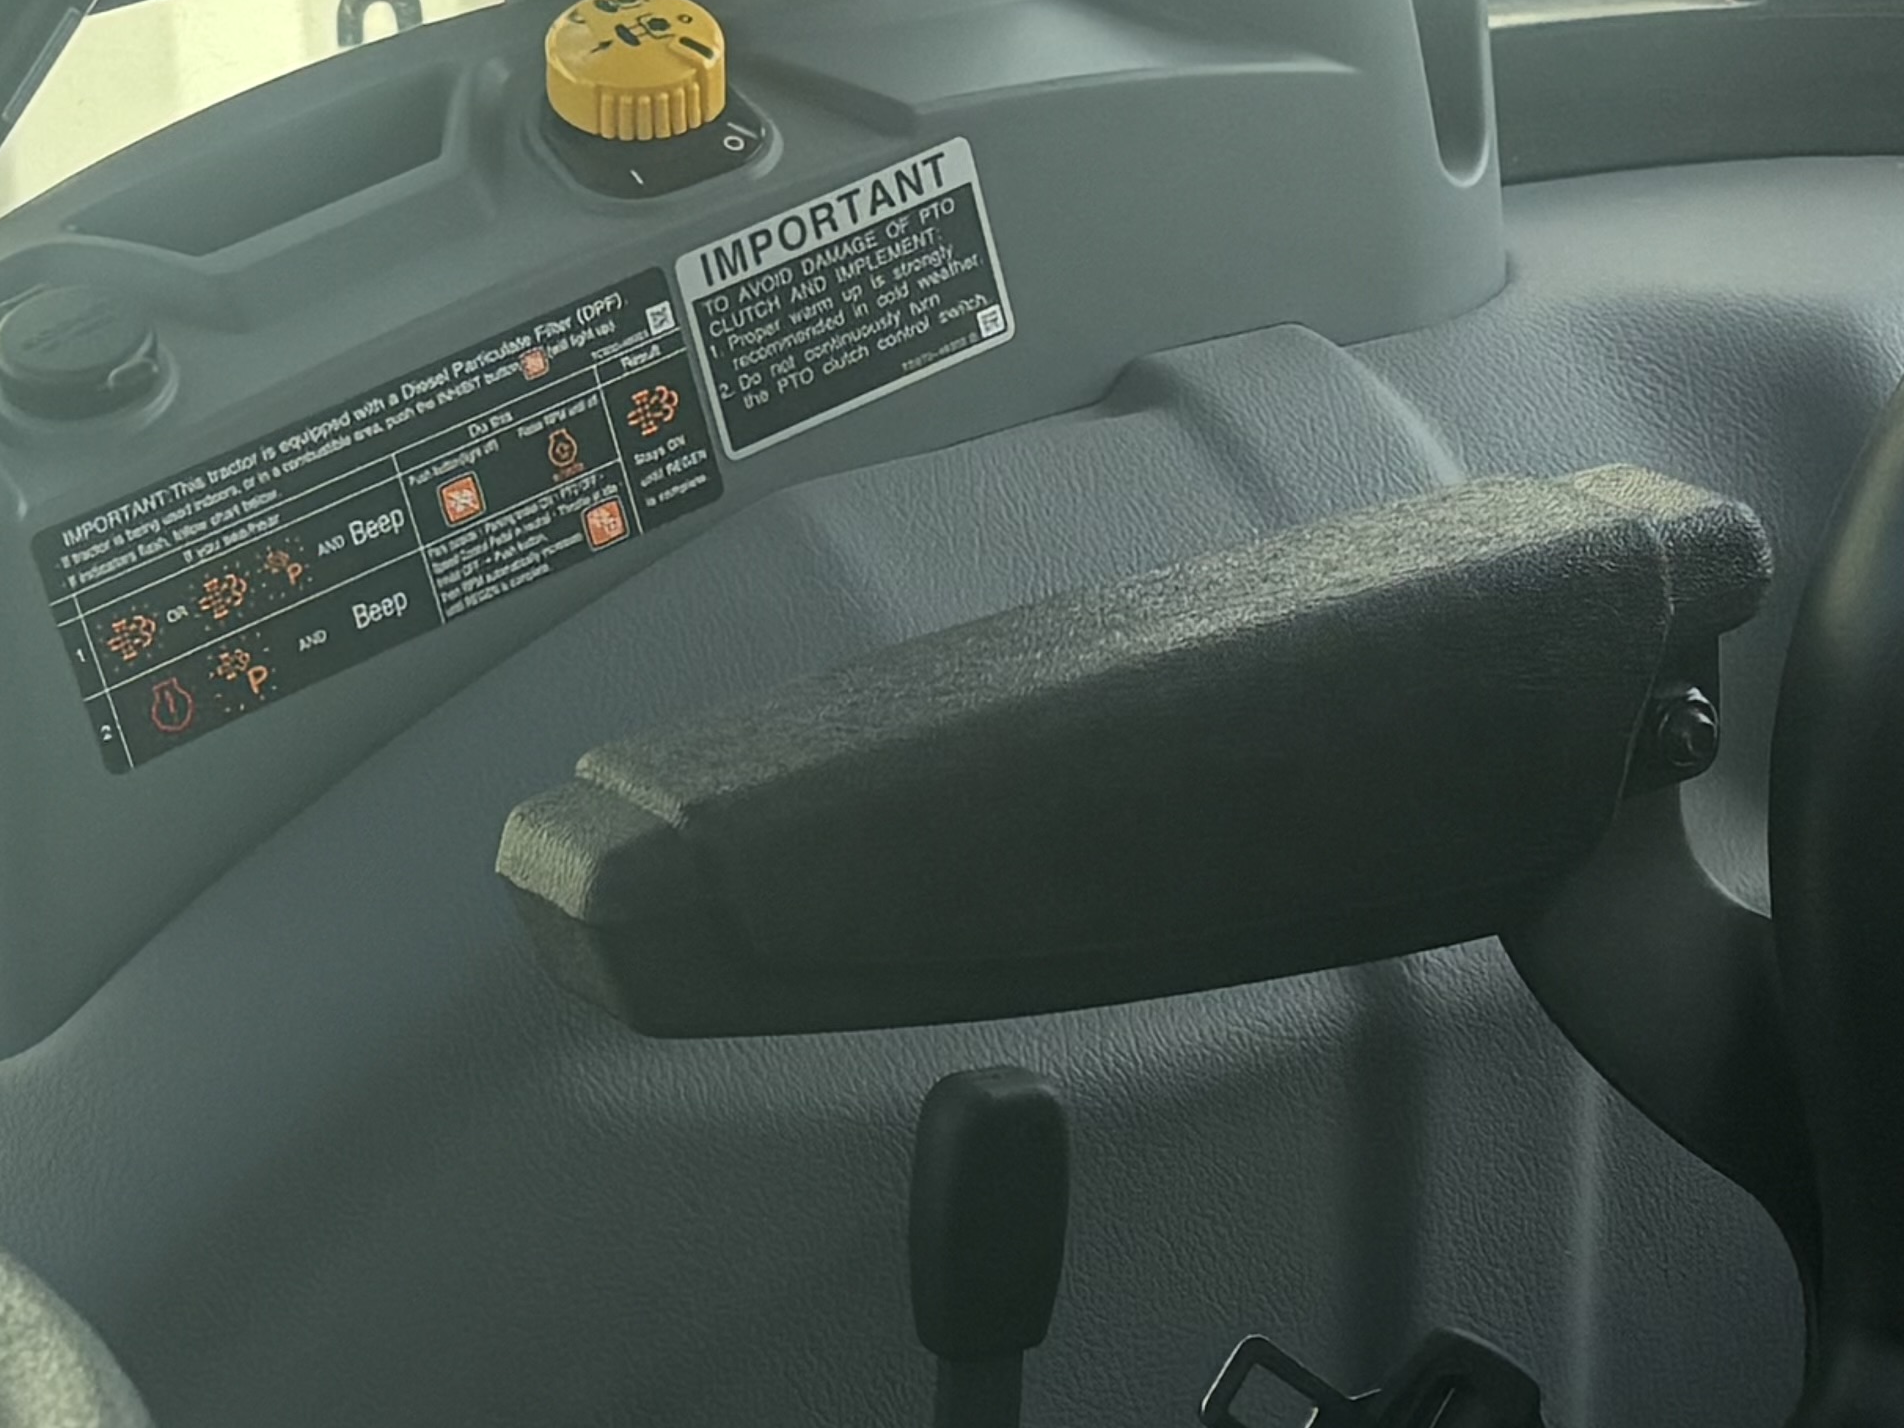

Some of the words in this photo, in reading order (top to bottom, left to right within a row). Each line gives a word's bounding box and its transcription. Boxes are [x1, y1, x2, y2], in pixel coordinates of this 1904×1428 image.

[699, 151, 946, 287] IMPORTANT
[704, 294, 731, 319] TO
[735, 265, 794, 305] AVOID
[800, 229, 878, 278] DAMAGE
[883, 214, 911, 240] OF
[917, 194, 956, 225] PTO
[707, 293, 782, 340] CLUTCH
[788, 273, 828, 304] AND
[834, 223, 943, 285] IMPLEMENT:
[726, 315, 782, 356] Proper
[787, 294, 834, 327] warm
[840, 281, 864, 305] up
[870, 271, 886, 290] is
[891, 241, 955, 284] strongly
[731, 309, 845, 373] recommended
[851, 298, 869, 319] in
[875, 280, 910, 309] cold
[737, 367, 762, 392] Do
[768, 353, 796, 379] not
[802, 306, 903, 366] continuously
[908, 289, 941, 317] turn
[742, 386, 769, 411] the
[776, 365, 815, 395] PTO
[820, 341, 870, 376] clutch
[874, 313, 931, 352] control
[206, 450, 259, 485] tractor
[259, 441, 277, 462] is
[276, 410, 352, 457] equipped
[351, 395, 386, 422] with
[386, 391, 399, 407] a
[399, 366, 451, 401] Diesel
[450, 330, 533, 379] Particulate
[533, 312, 573, 343] Filter
[314, 532, 347, 558] AND
[346, 501, 408, 552] Beep
[164, 603, 189, 624] OR
[296, 627, 329, 653] AND
[350, 582, 411, 635] Beep
[98, 722, 114, 742] 2
